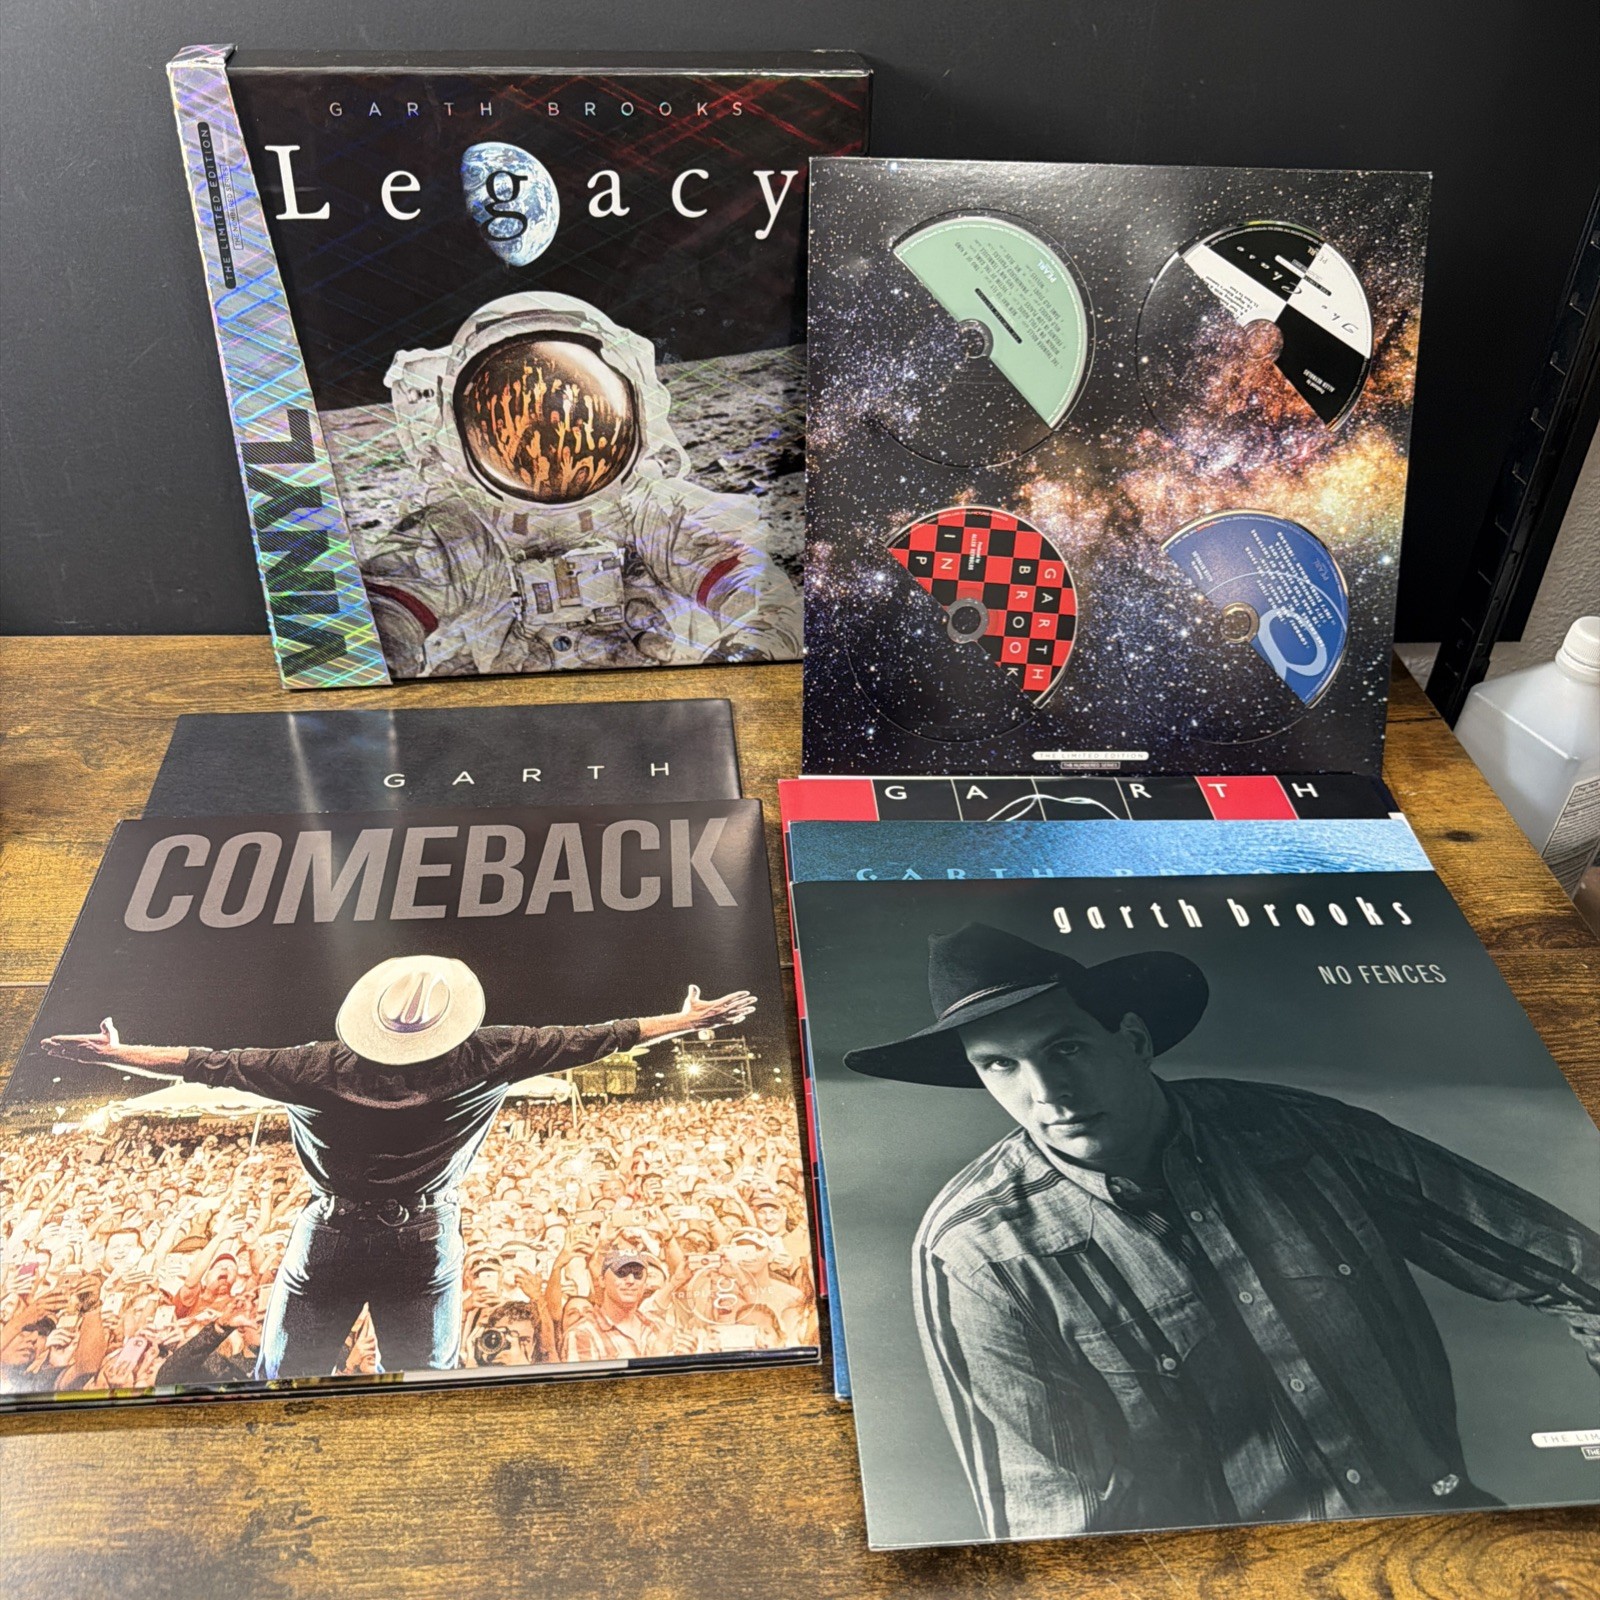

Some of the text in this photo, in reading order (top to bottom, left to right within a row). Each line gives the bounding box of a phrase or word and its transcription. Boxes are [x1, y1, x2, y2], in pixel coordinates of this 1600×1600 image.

[329, 102, 743, 117] GARTH BROOKS
[201, 129, 232, 280] THE LIMITED EDITION
[264, 145, 799, 242] Legacy
[240, 409, 348, 678] VINYL
[384, 762, 670, 788] GARTH
[884, 782, 1319, 800] GARTH
[124, 816, 739, 932] COMEBACK
[1053, 896, 1412, 934] garth brooks
[1318, 964, 1447, 986] NO FENCES
[1542, 1435, 1568, 1444] THE
